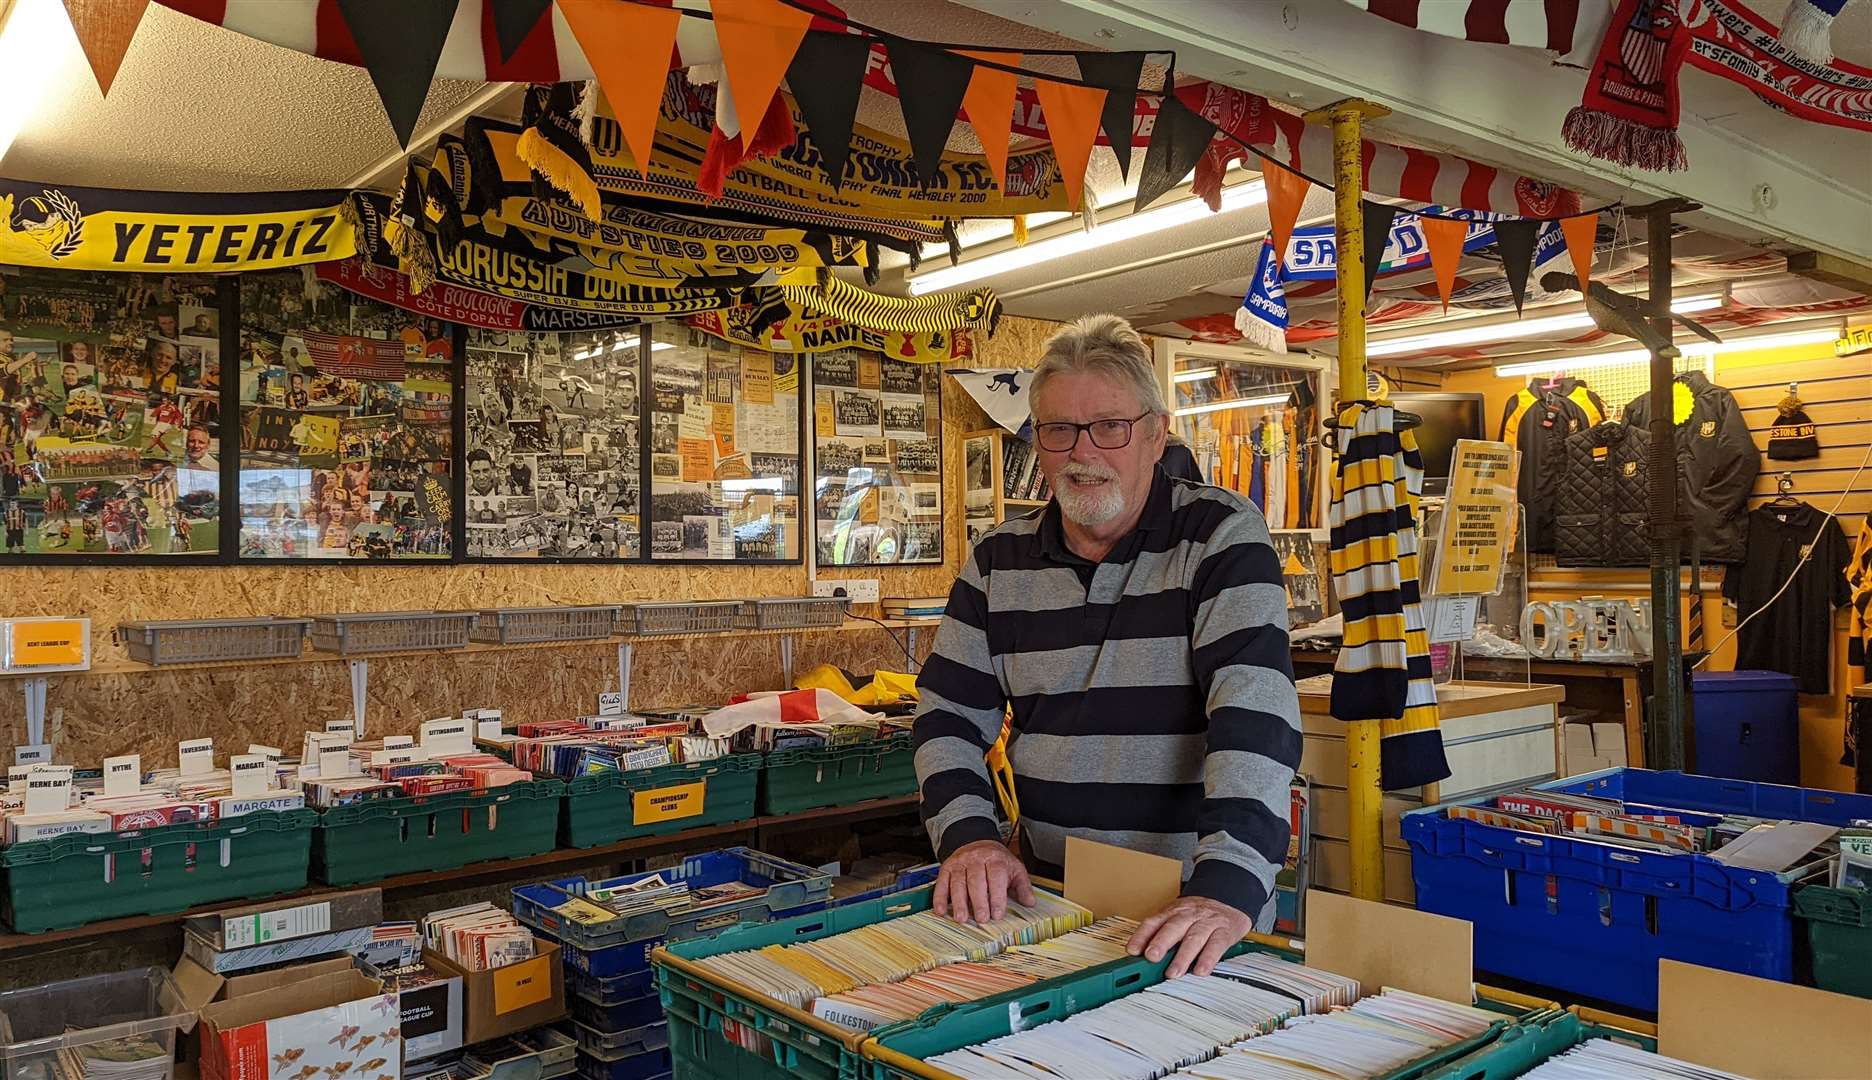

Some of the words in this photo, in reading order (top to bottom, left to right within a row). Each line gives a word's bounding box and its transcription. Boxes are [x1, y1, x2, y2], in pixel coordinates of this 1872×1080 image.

[818, 172, 867, 193] TRPHY
[870, 184, 902, 200] FINAL
[907, 190, 957, 203] WEMBLEY
[959, 191, 987, 204] 2000
[443, 286, 516, 318] BOULOGNE
[513, 290, 552, 304] SUPER
[593, 301, 626, 312] SUPER
[1249, 291, 1288, 320] SAMPDORIA
[456, 310, 513, 328] D'OPALE
[801, 329, 886, 351] NANTES
[1521, 599, 1654, 661] OPEN
[112, 762, 133, 773] HYTHE
[235, 761, 266, 771] MARGATE
[29, 780, 53, 789] HERNE
[53, 779, 68, 788] BAY
[232, 798, 292, 814] MARGATE
[649, 792, 689, 805] CHAMPIONSHIP
[1502, 801, 1530, 814] THE
